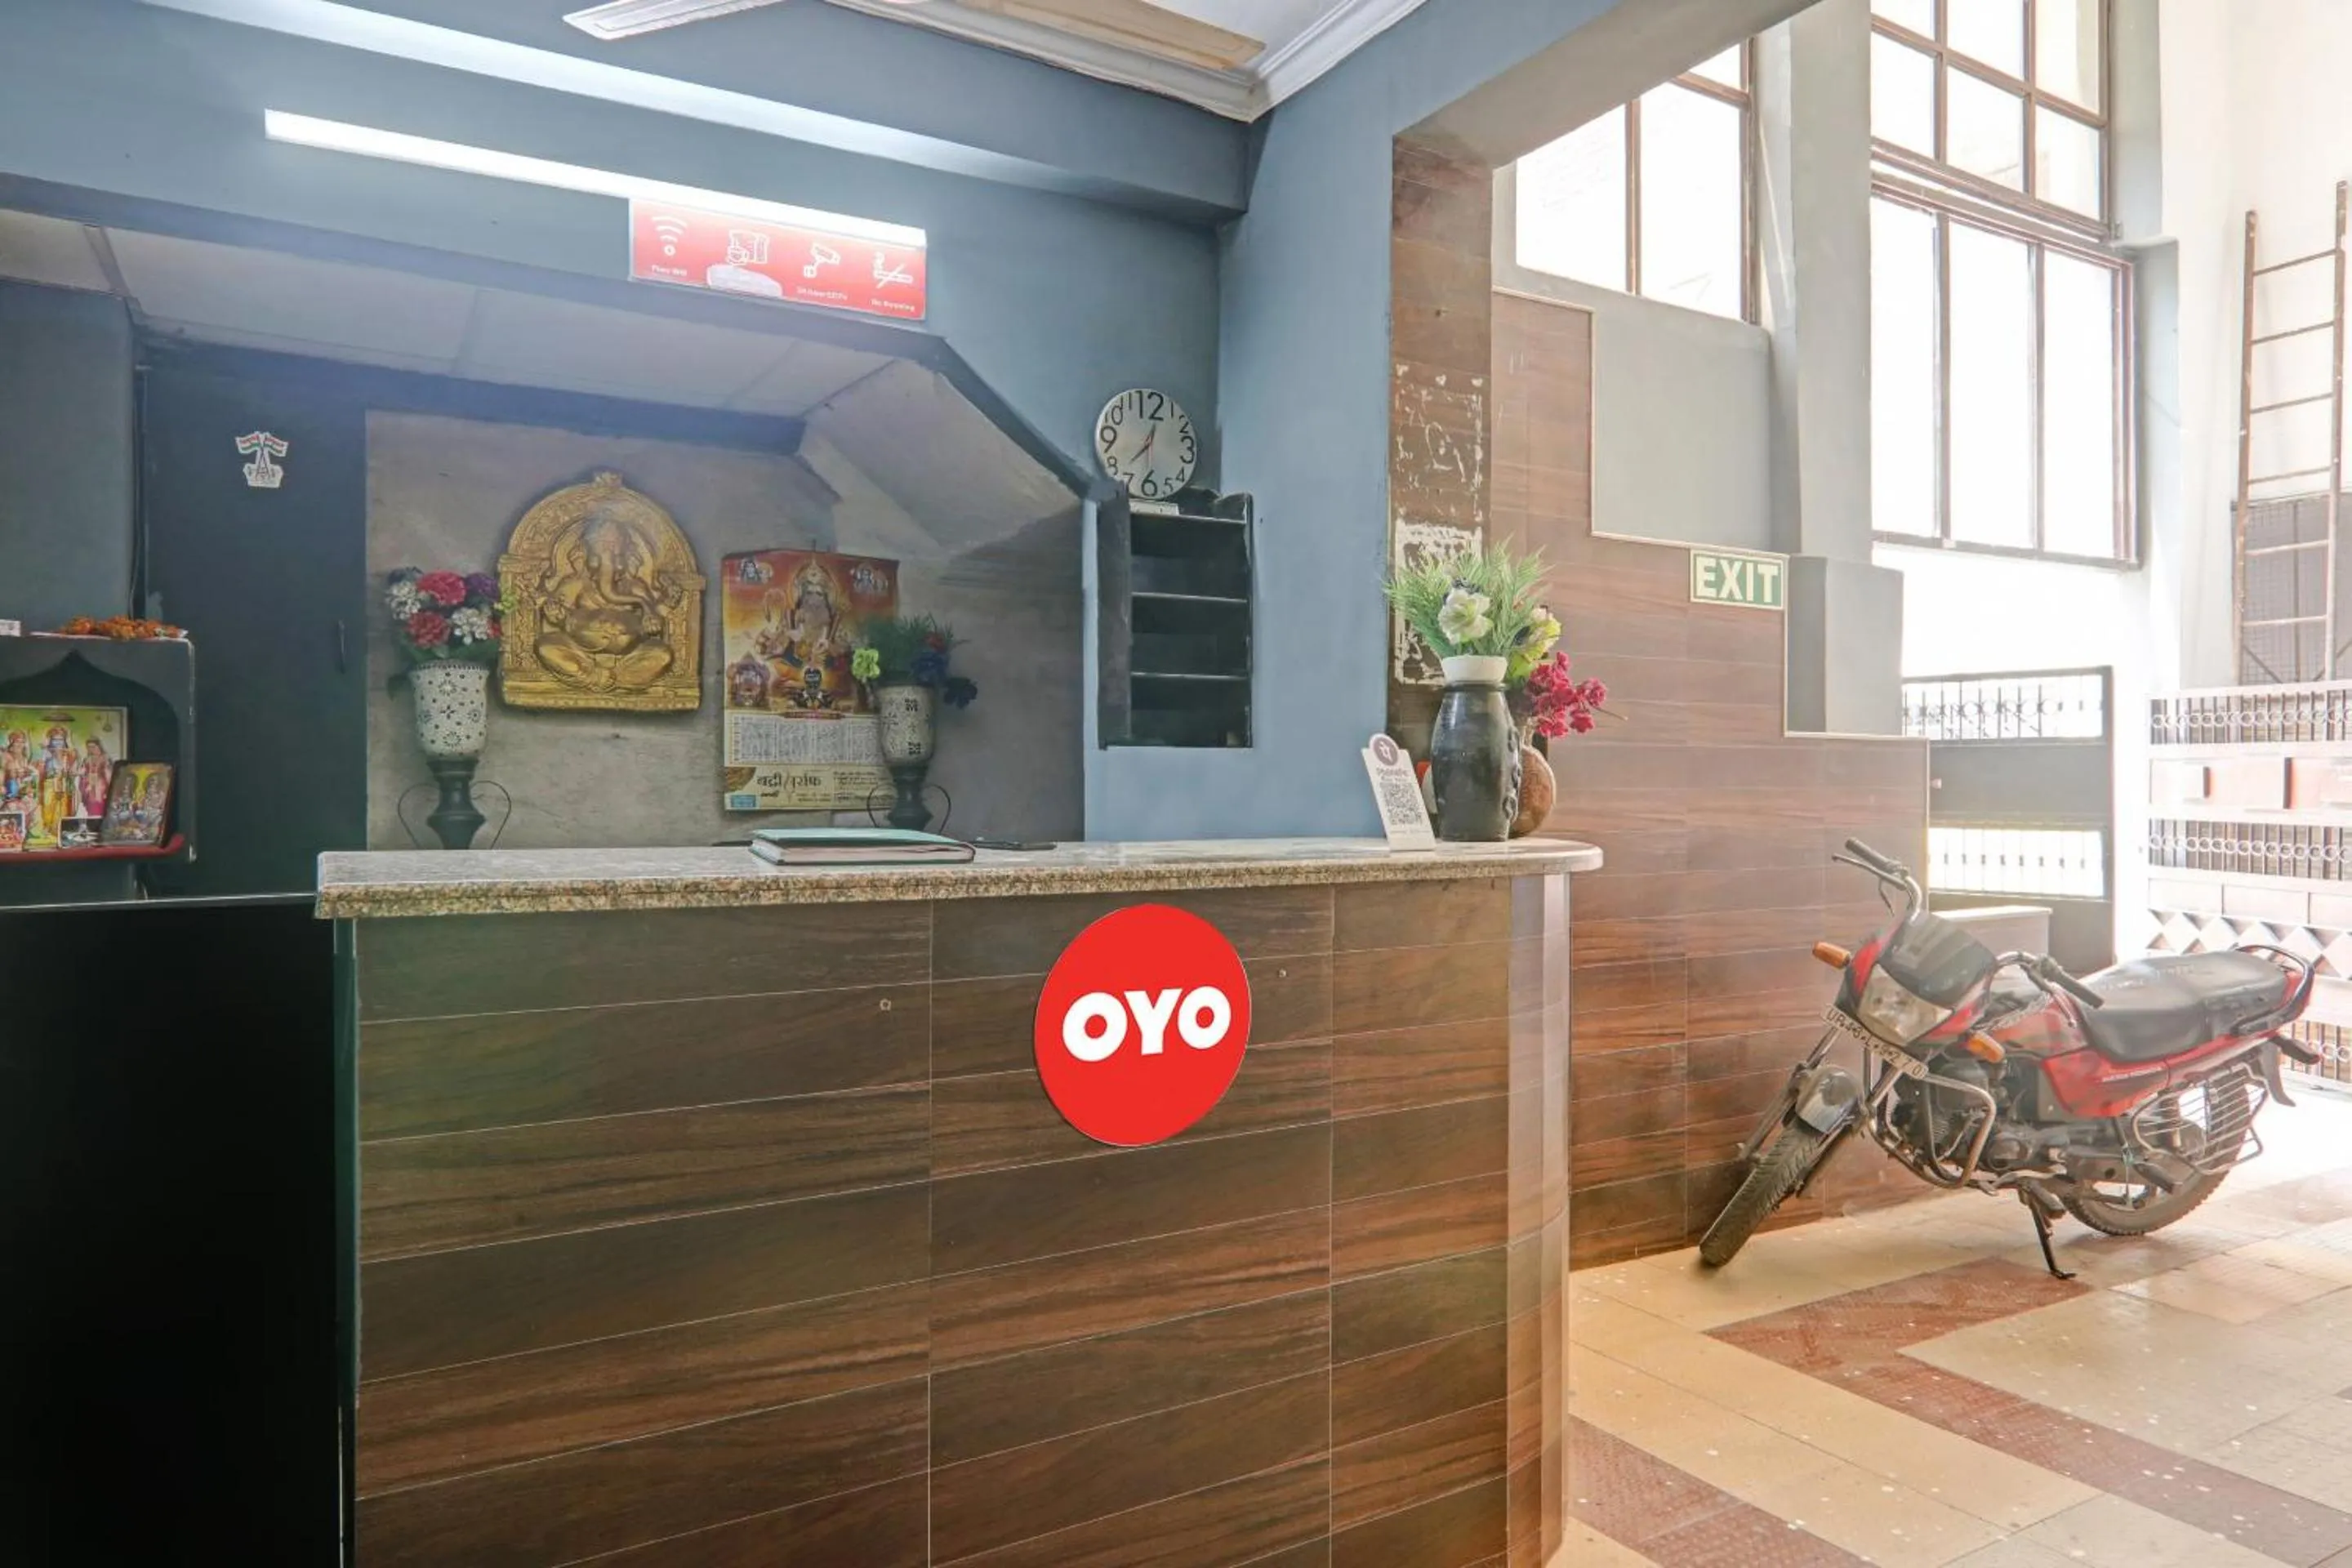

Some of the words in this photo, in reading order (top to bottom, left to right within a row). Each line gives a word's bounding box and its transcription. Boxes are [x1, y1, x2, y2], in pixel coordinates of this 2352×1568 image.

[1135, 390, 1164, 421] 12
[1178, 415, 1189, 434] 2
[1100, 425, 1117, 453] 9
[1180, 435, 1195, 464] 3
[1107, 456, 1118, 475] 8
[1123, 472, 1135, 486] 7
[1176, 466, 1185, 483] 4
[1141, 470, 1158, 497] 6
[1163, 477, 1174, 495] 5
[1695, 556, 1779, 603] EXIT
[1062, 986, 1232, 1062] OYO
